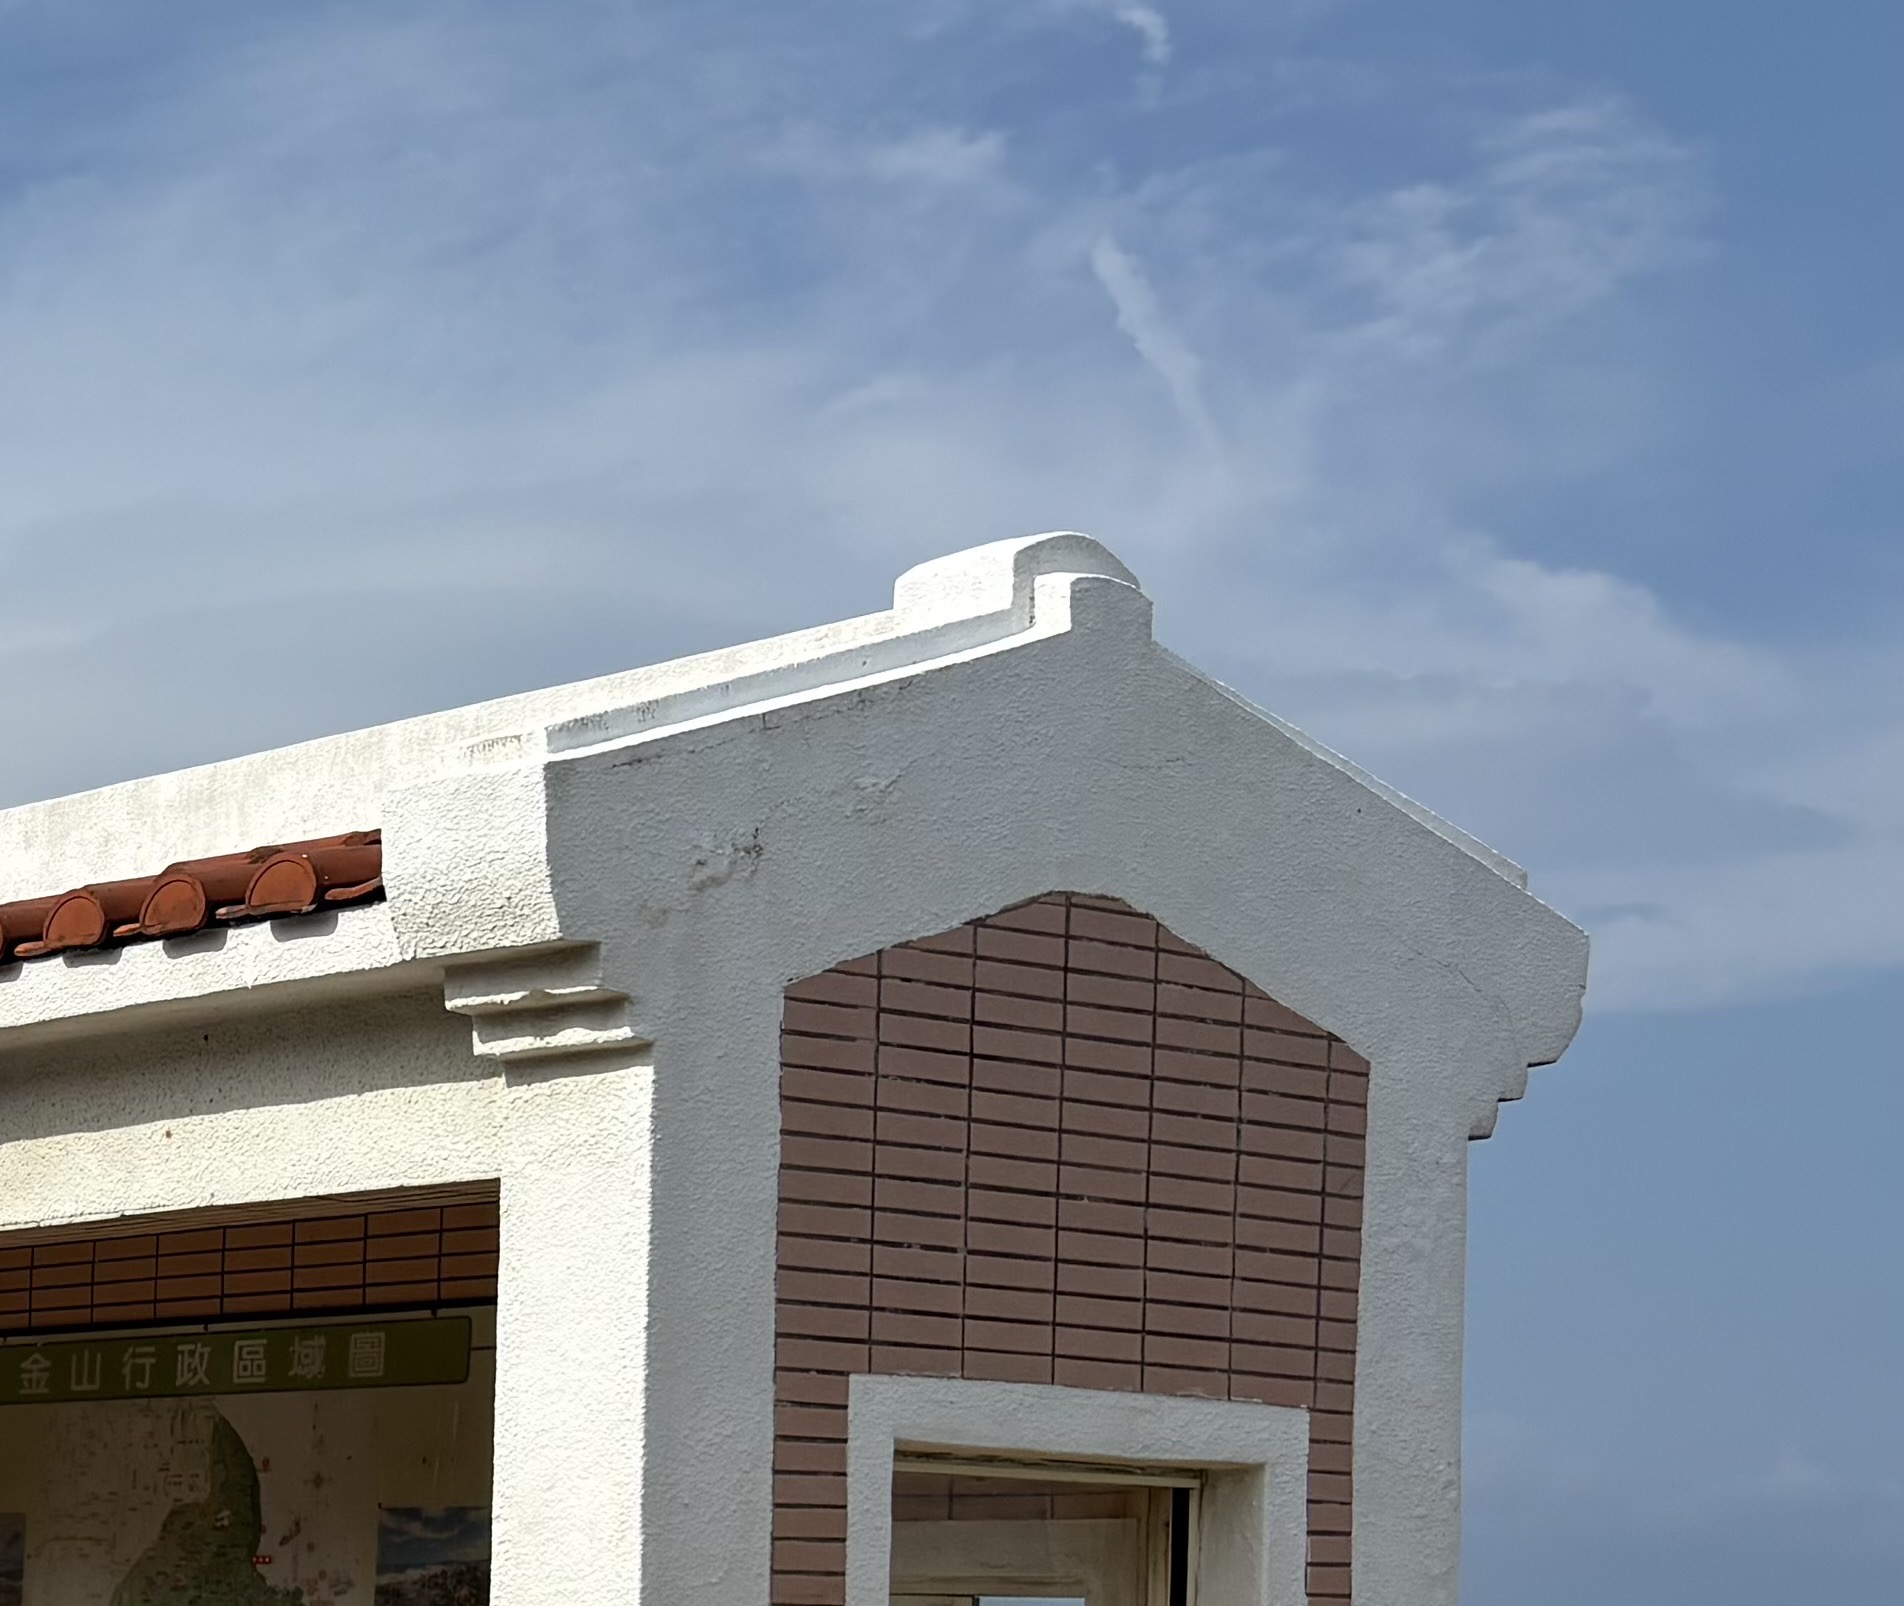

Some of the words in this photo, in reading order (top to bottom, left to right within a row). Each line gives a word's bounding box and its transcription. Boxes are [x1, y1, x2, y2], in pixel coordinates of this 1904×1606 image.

[17, 1331, 386, 1395] 金山行政區域圖
